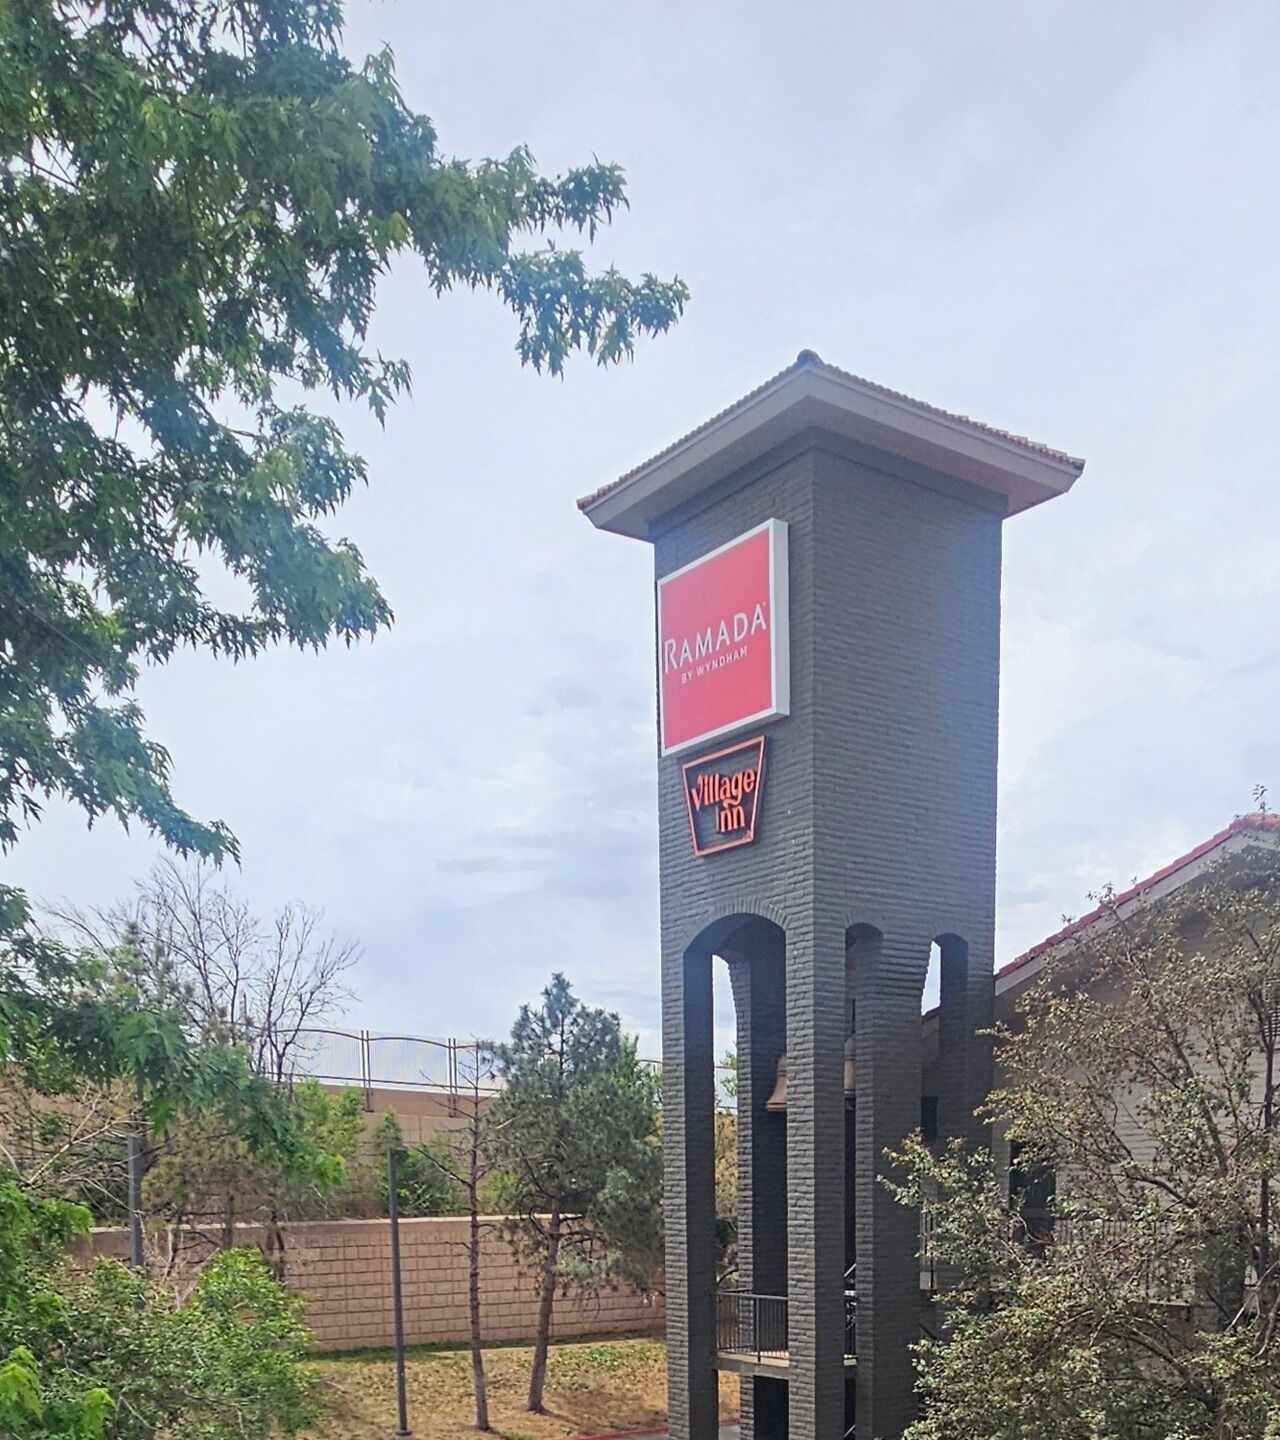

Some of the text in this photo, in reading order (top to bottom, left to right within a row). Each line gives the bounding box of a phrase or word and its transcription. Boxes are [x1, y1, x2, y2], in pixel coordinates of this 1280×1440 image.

[664, 603, 767, 674] RAMADA
[681, 645, 748, 685] BY WYNDHAM
